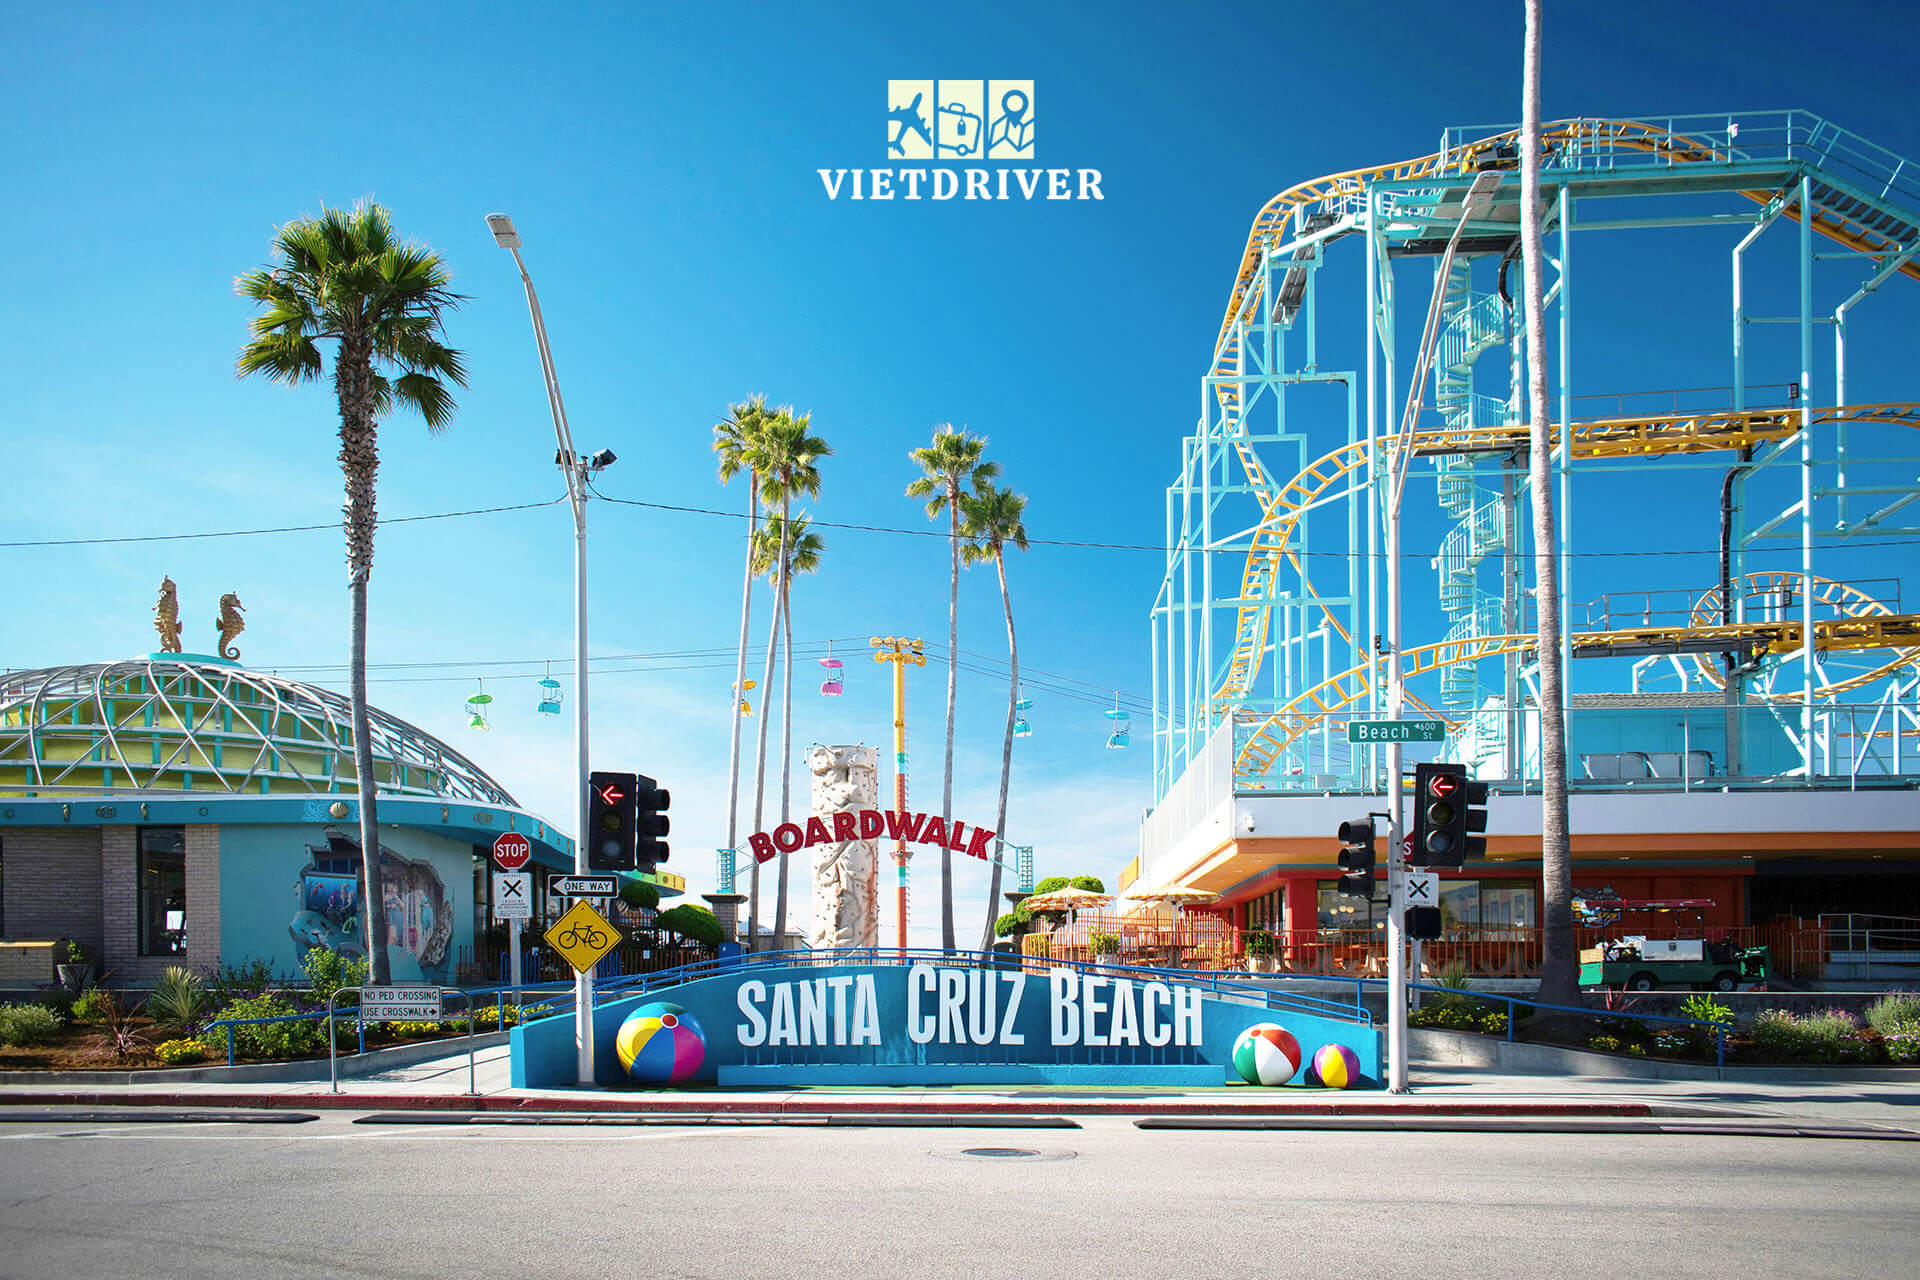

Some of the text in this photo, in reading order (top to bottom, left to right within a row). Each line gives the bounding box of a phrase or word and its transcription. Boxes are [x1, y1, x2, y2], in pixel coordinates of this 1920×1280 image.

[1359, 724, 1432, 740] Beach St
[1420, 722, 1436, 731] 600
[748, 809, 997, 864] BOARDWALK
[496, 843, 528, 857] STOP
[564, 882, 610, 890] ONE WAY
[364, 991, 437, 1000] NO PED CROSSING
[736, 963, 1203, 1047] SANTA CRUZ BEACH
[364, 1007, 428, 1016] USE CROSSWALK
